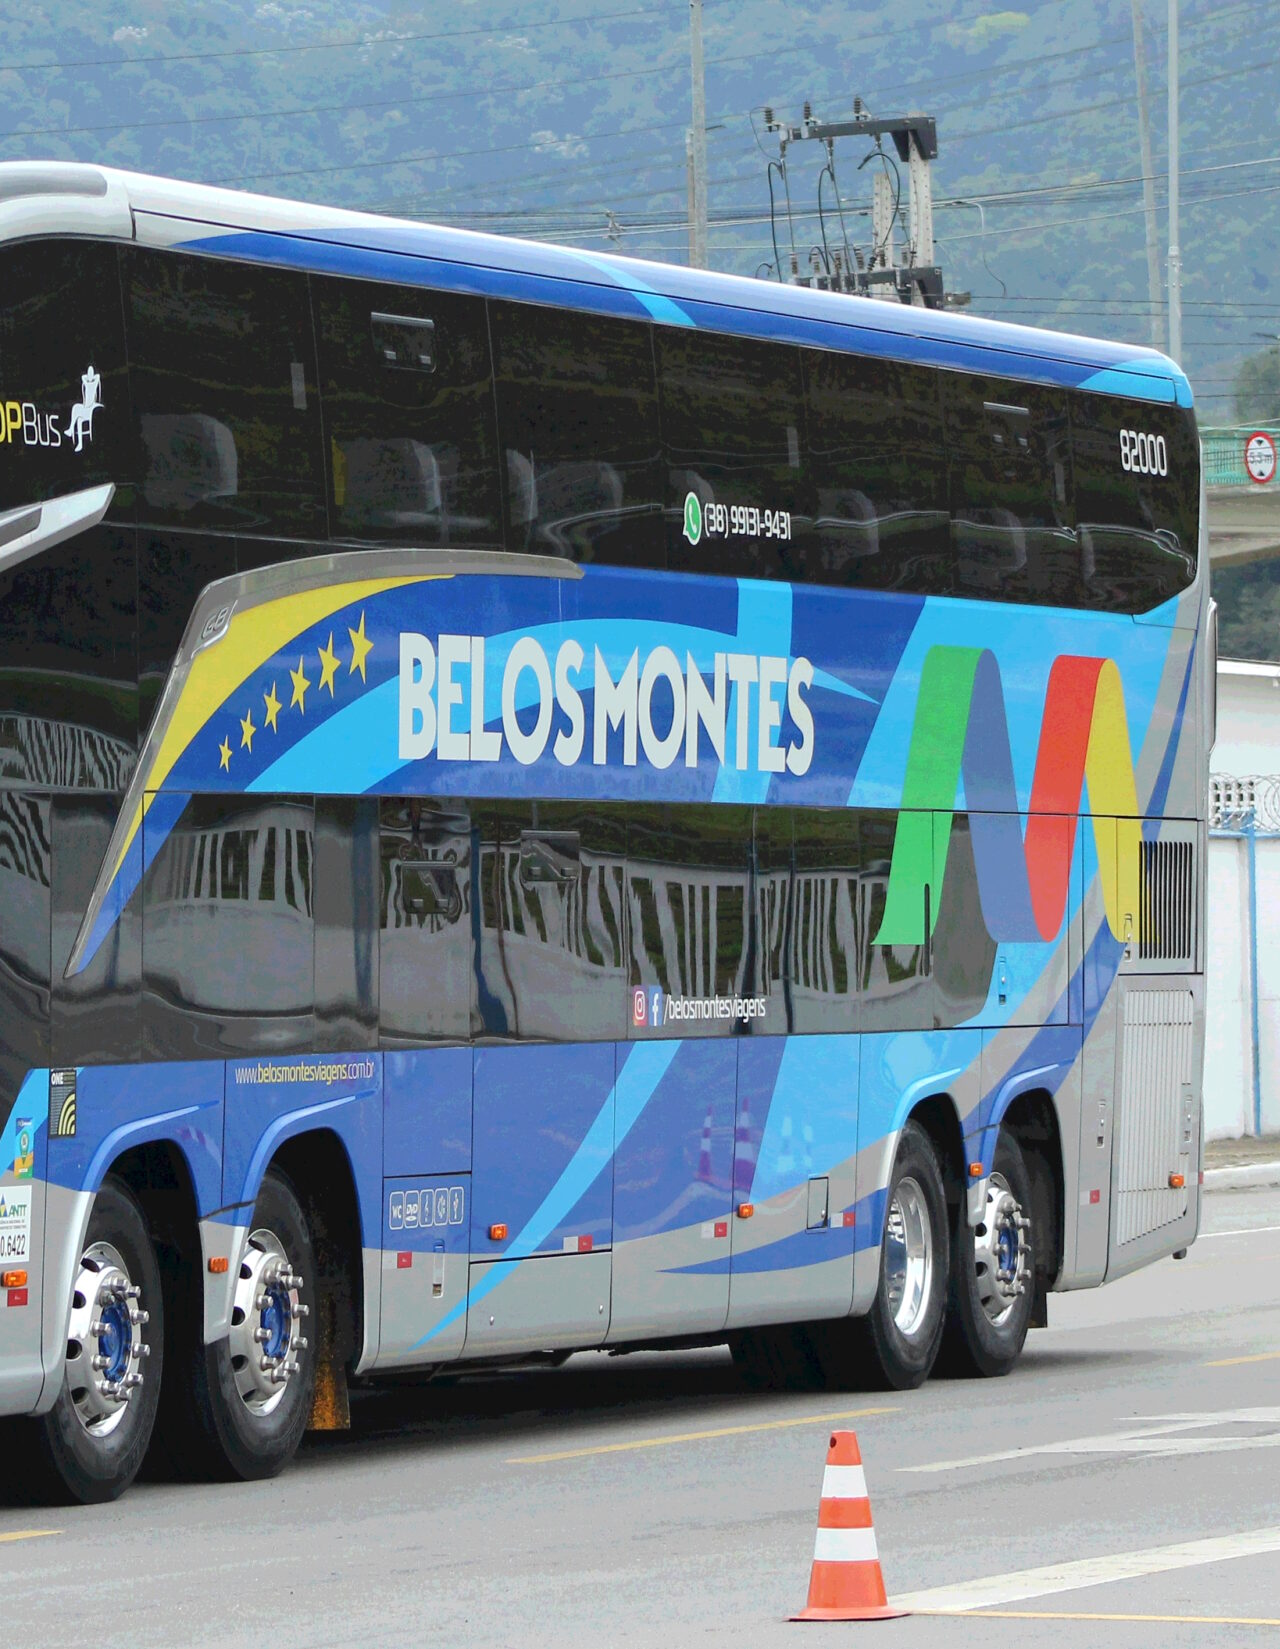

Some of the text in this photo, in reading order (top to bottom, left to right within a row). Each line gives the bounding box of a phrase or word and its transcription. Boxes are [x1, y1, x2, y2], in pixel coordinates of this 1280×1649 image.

[1119, 428, 1168, 477] 82000
[704, 502, 792, 541] (38) 99131-9431
[234, 1058, 375, 1085] www.belosmontesviagens.com.br
[8, 1204, 28, 1217] ANTT
[391, 1204, 402, 1219] WC
